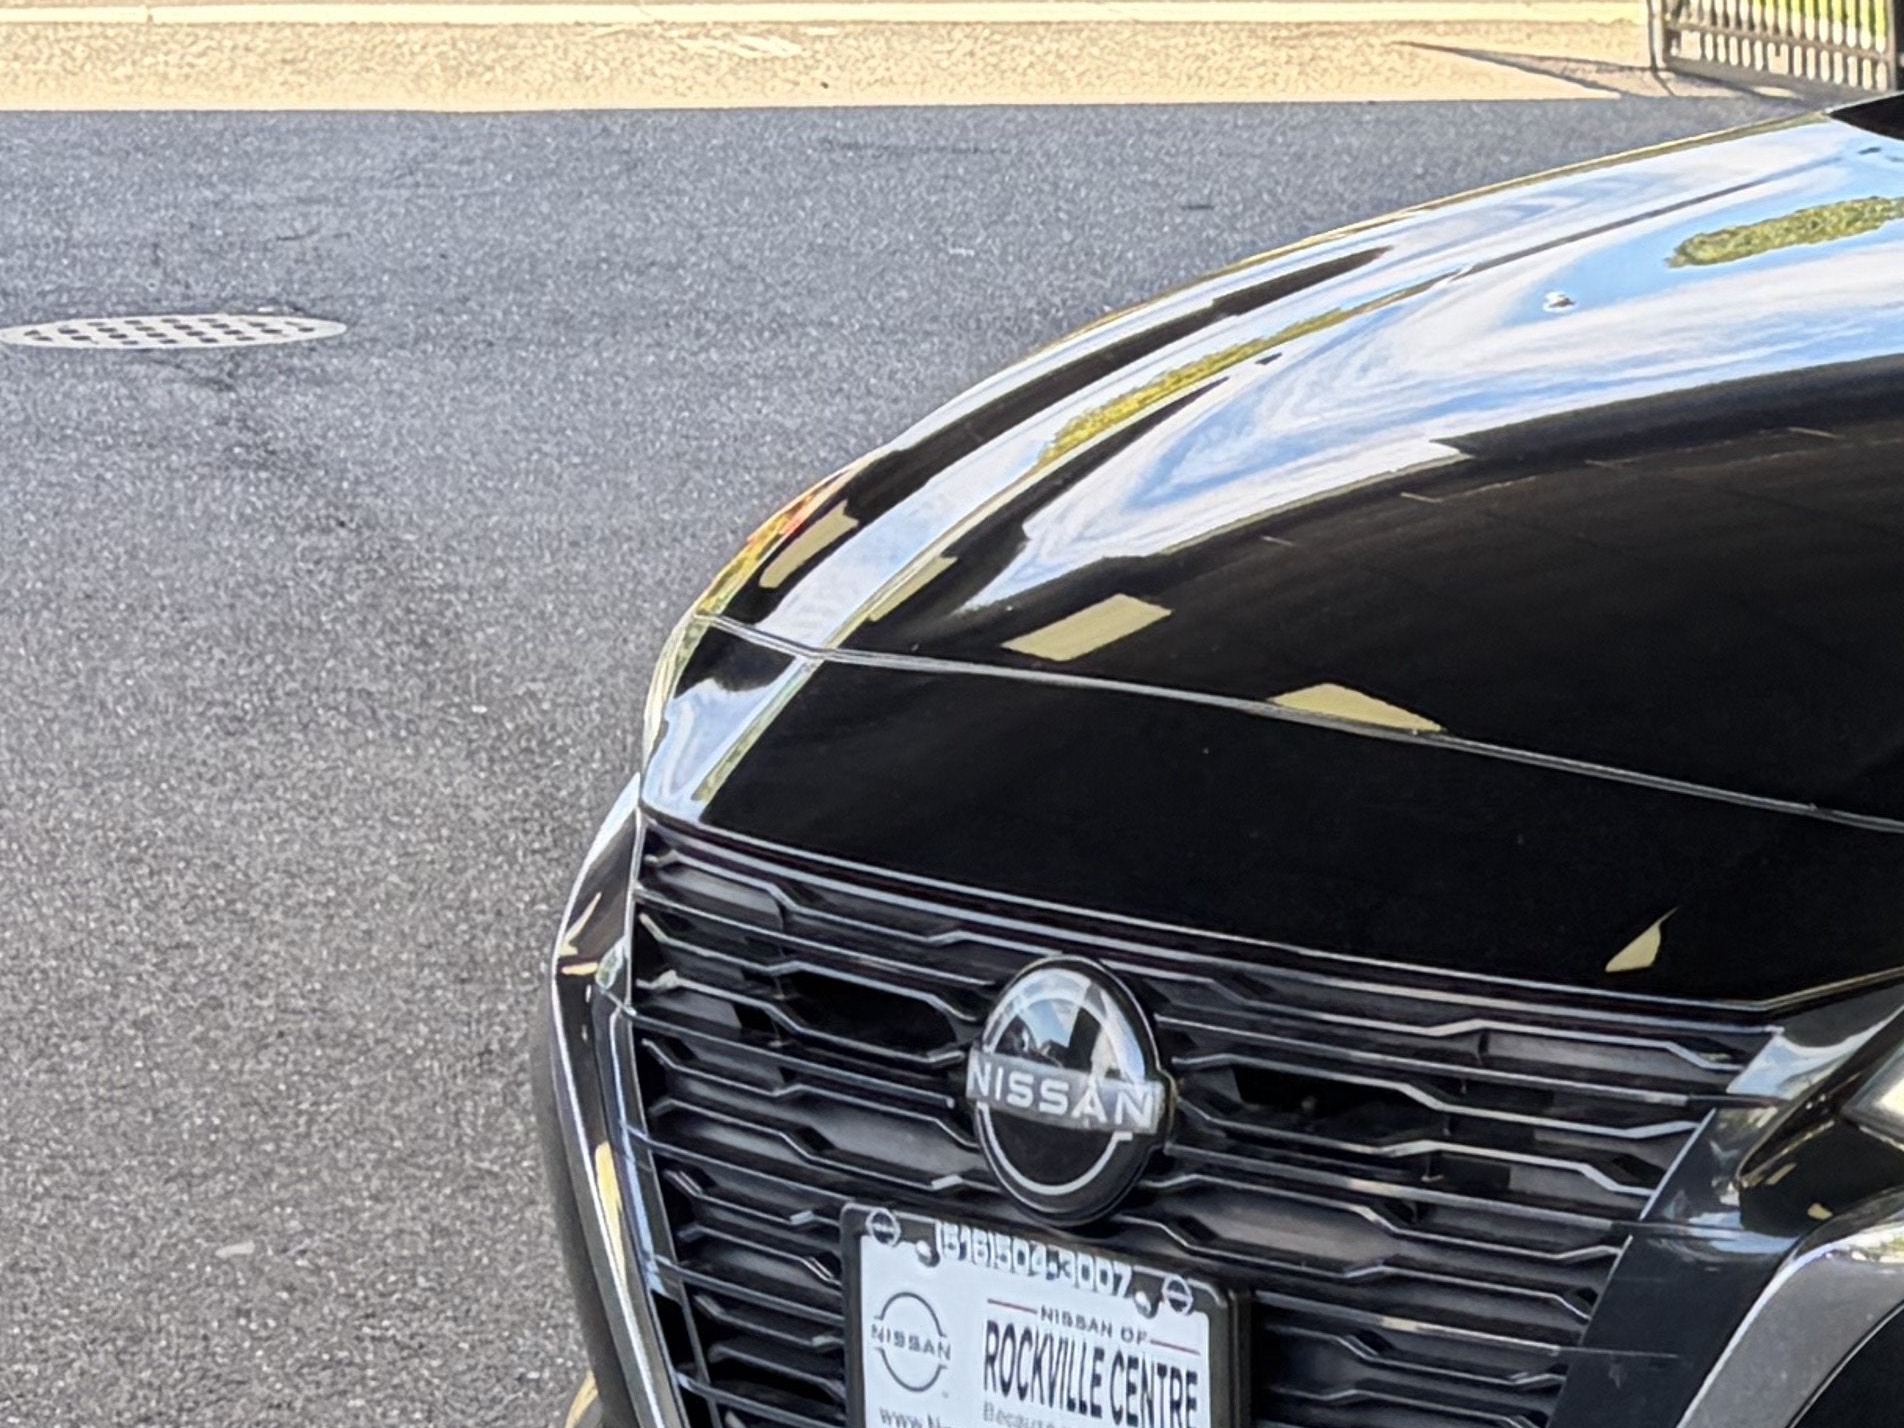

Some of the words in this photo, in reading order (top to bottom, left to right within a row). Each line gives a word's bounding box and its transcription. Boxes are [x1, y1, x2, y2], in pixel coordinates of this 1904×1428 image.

[968, 1053, 1154, 1129] NISSAN
[870, 1323, 951, 1361] NISSAN
[1041, 1305, 1112, 1339] NISSAN
[1120, 1325, 1147, 1345] OF
[984, 1319, 1105, 1420] ROCKVILLE
